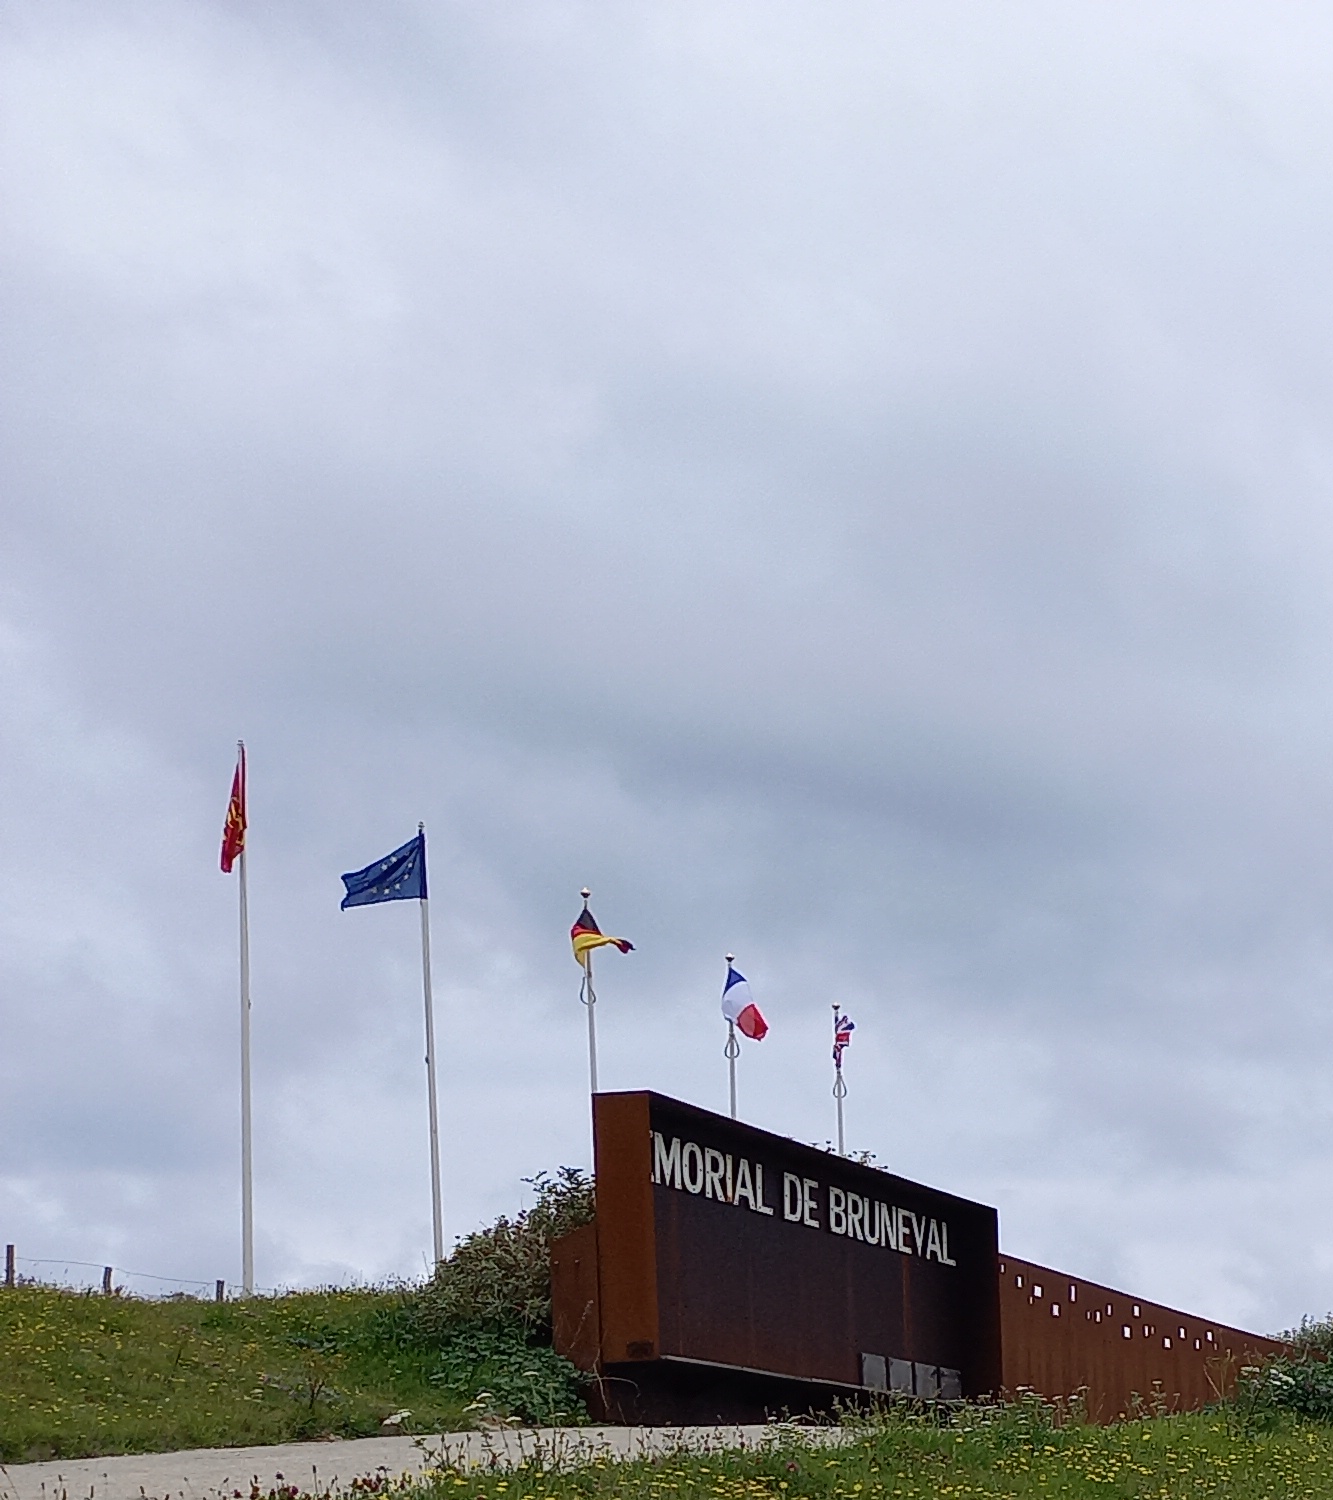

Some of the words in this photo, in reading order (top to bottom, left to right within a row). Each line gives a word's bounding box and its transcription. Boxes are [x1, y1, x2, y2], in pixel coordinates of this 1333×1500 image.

[649, 1130, 774, 1216] MORIAL
[783, 1171, 820, 1229] DE
[829, 1185, 957, 1267] BRUNEVAL
